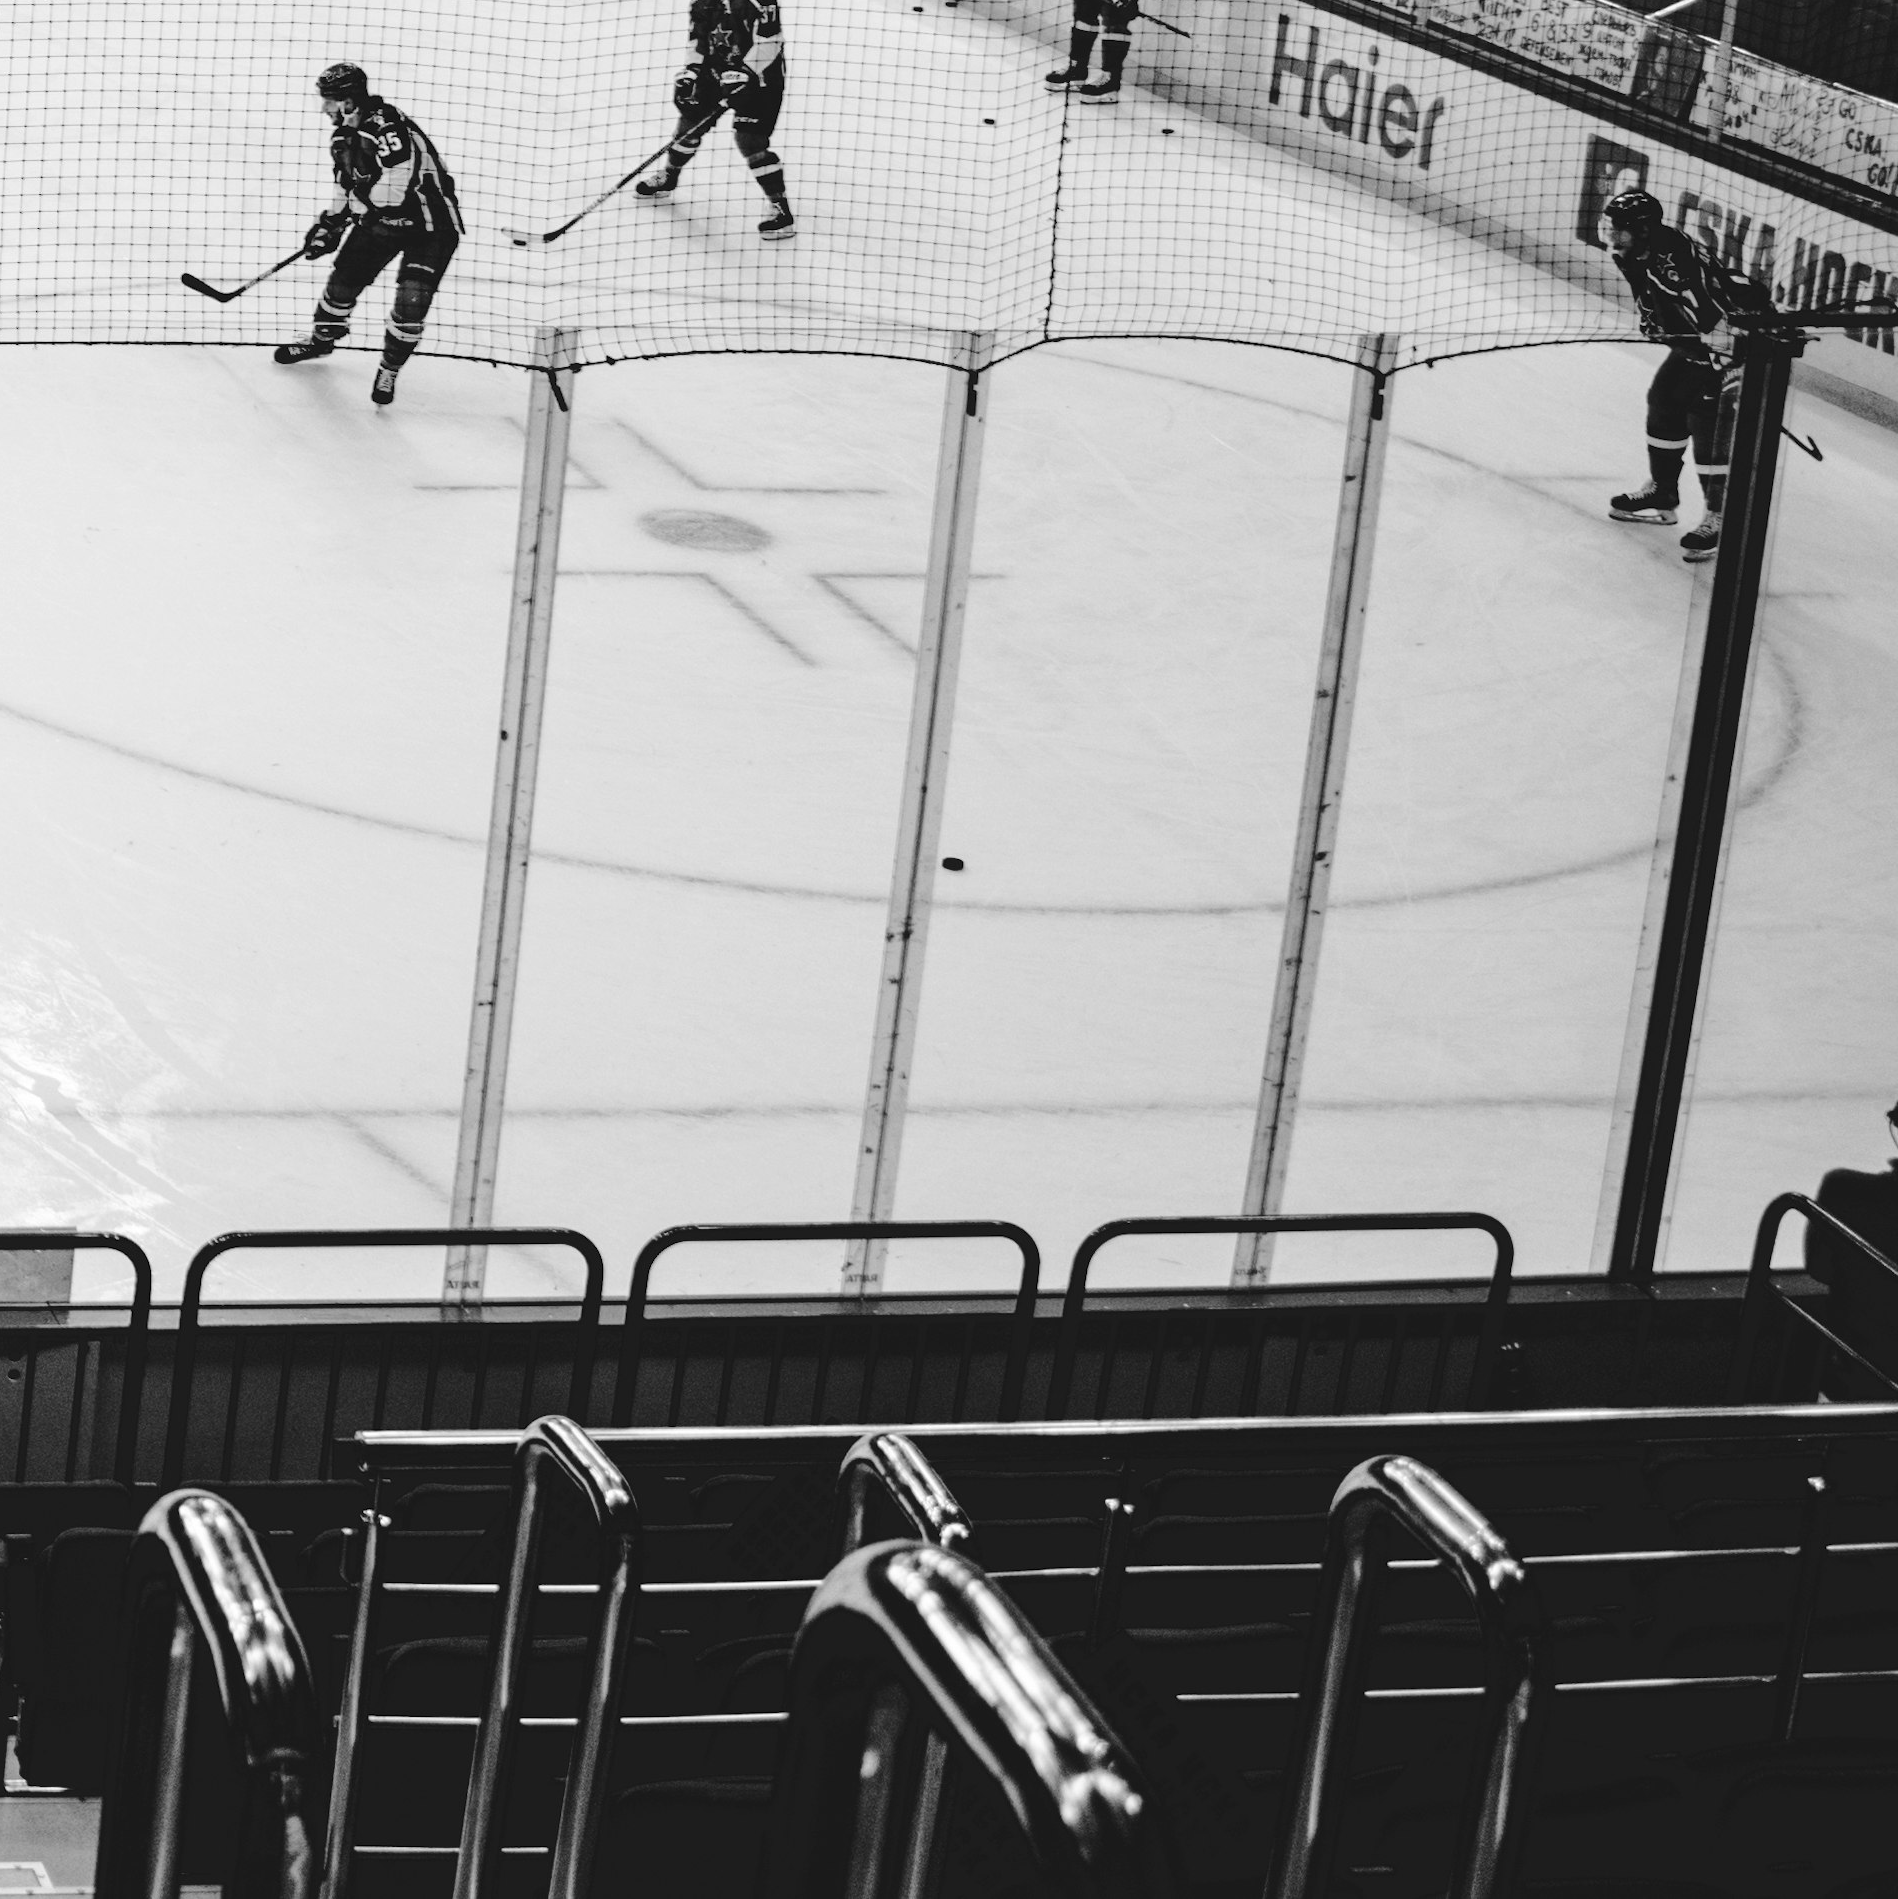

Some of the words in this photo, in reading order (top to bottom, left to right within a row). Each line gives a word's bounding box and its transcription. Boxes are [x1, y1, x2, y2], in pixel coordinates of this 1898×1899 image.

[759, 4, 776, 24] 37
[1268, 13, 1445, 171] Haier
[1838, 98, 1857, 120] GO
